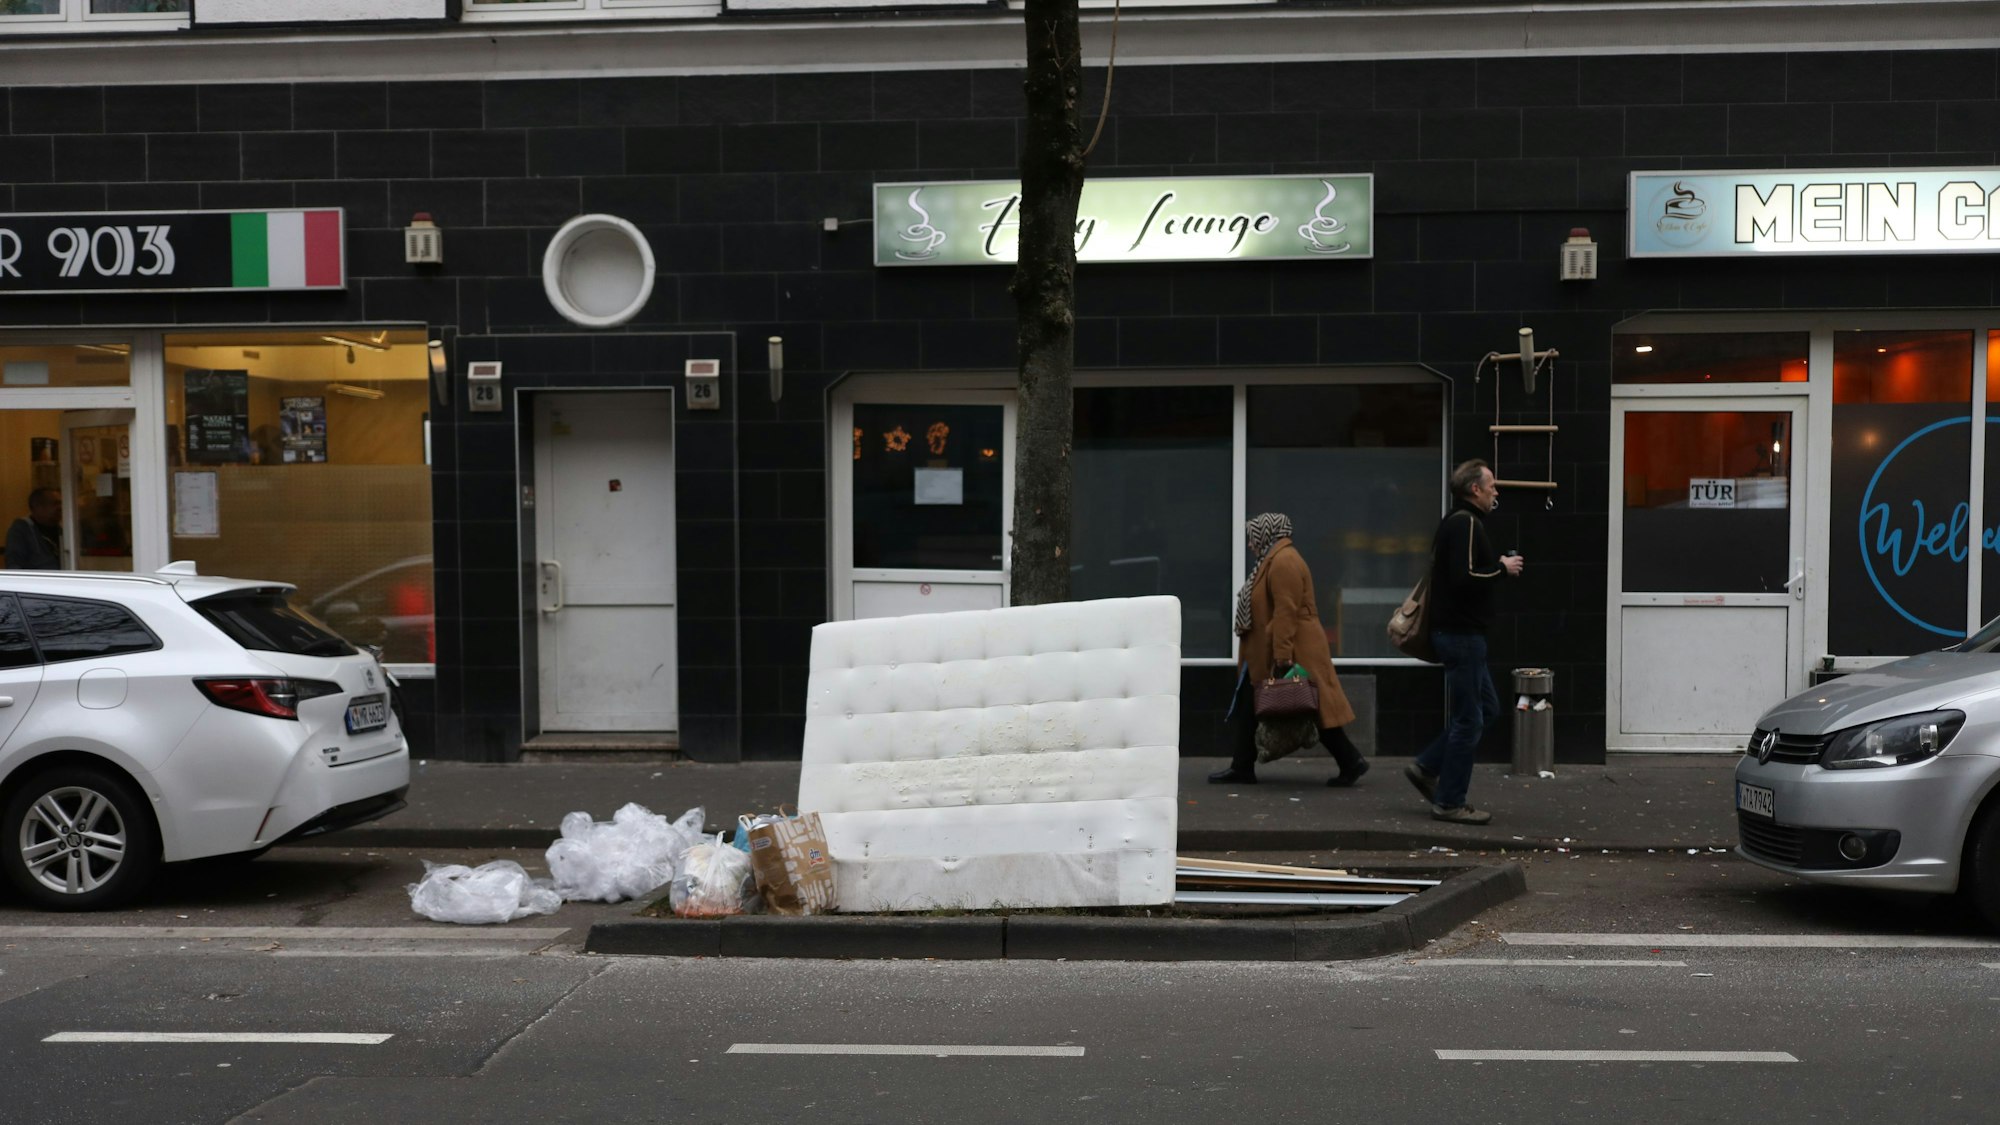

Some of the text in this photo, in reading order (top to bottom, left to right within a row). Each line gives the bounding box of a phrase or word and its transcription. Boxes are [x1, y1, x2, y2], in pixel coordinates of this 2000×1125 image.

[1735, 180, 2000, 244] MEIN C
[47, 225, 176, 277] 903
[475, 386, 494, 401] 28
[694, 383, 712, 398] 26
[1691, 480, 1733, 500] TÜR
[1863, 498, 2000, 577] Welc
